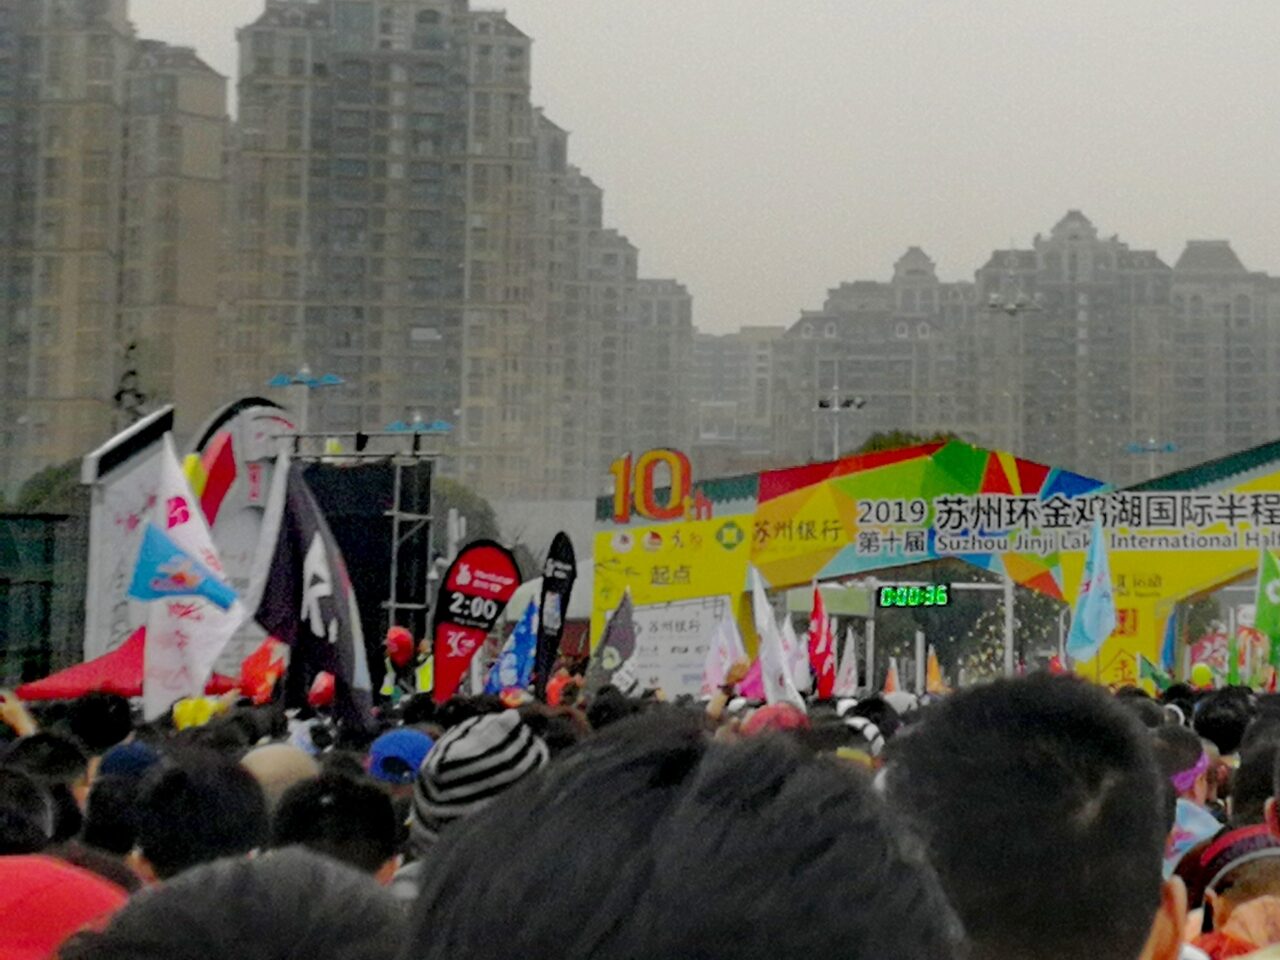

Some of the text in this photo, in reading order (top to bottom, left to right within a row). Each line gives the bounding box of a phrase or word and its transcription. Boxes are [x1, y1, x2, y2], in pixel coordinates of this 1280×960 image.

[858, 500, 925, 523] 2019
[754, 519, 843, 543] 苏州银行
[858, 530, 924, 552] 第十届
[937, 534, 1008, 551] Suzhou
[1015, 534, 1053, 554] Jinji
[1061, 534, 1097, 551] Lak
[1111, 532, 1238, 549] International
[449, 591, 499, 620] 2:00
